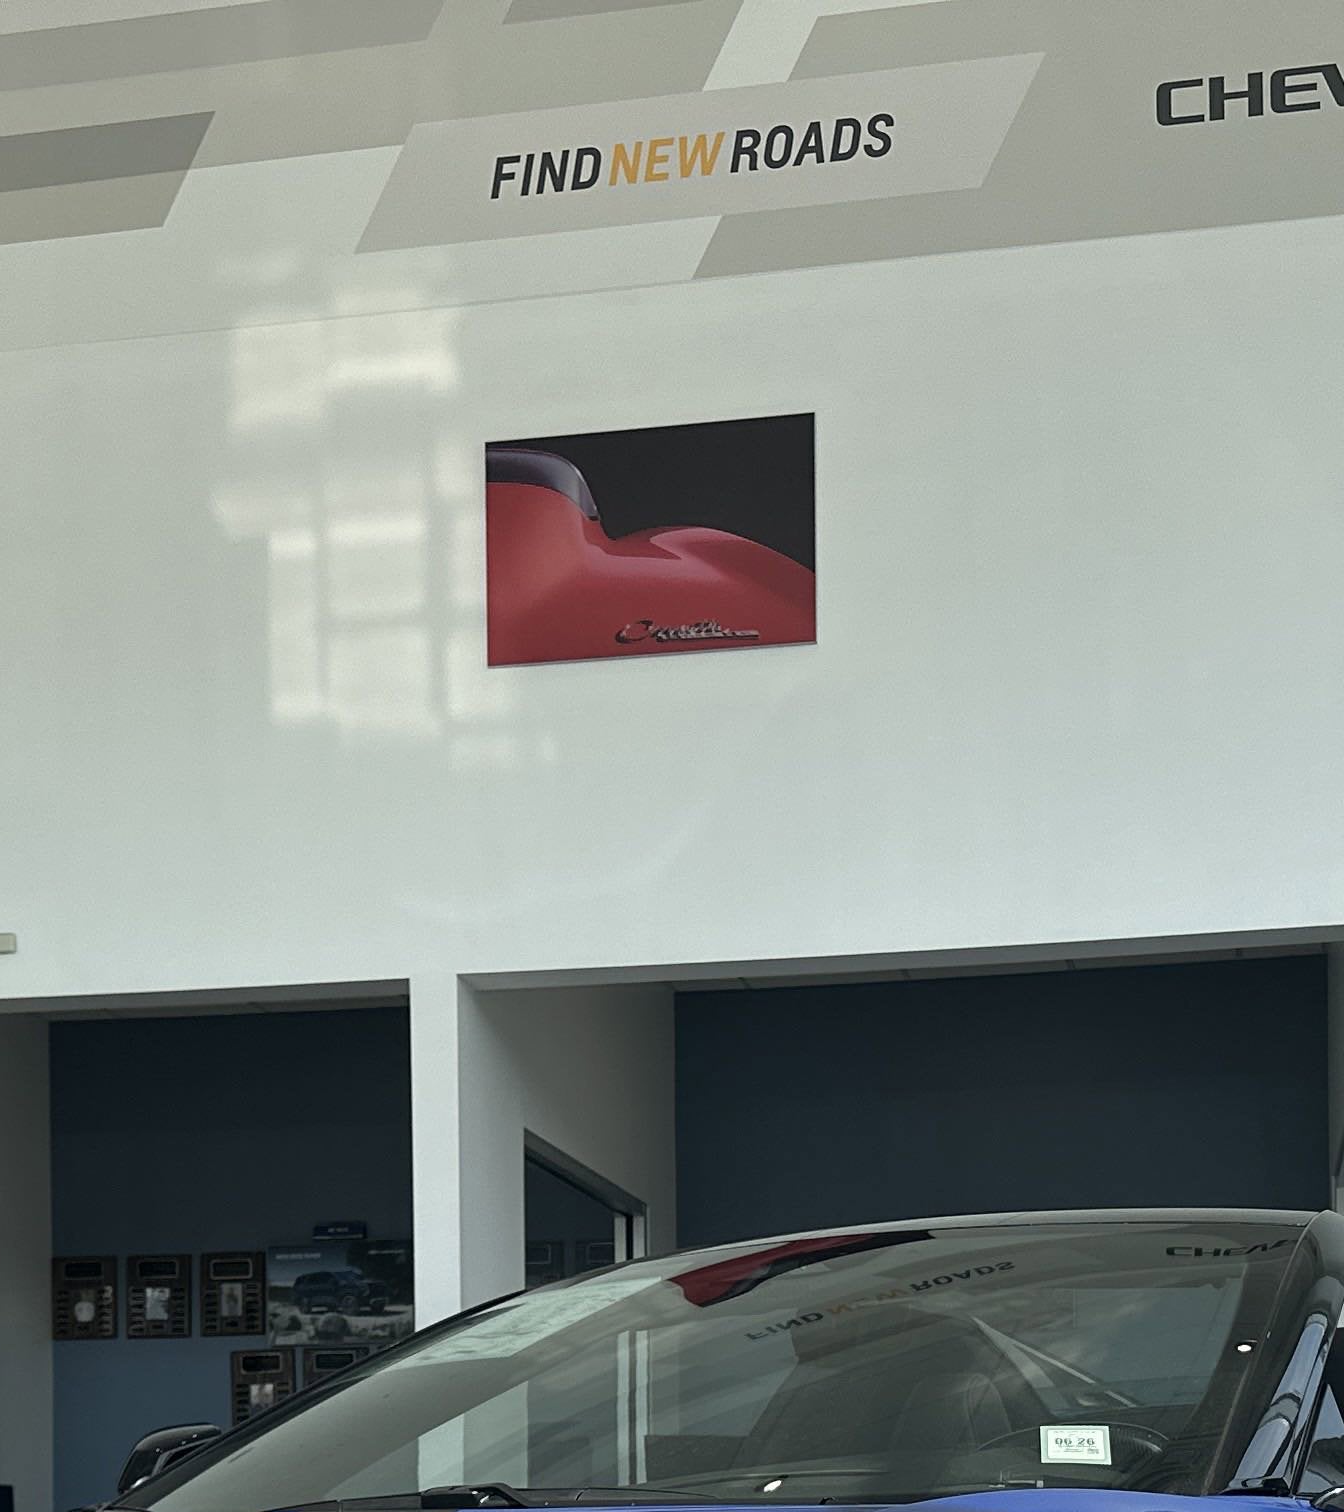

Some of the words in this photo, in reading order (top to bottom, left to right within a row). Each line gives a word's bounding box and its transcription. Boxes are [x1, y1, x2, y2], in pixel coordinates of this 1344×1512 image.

[490, 147, 601, 199] FIND
[609, 131, 725, 186] NEW
[730, 113, 894, 173] ROADS
